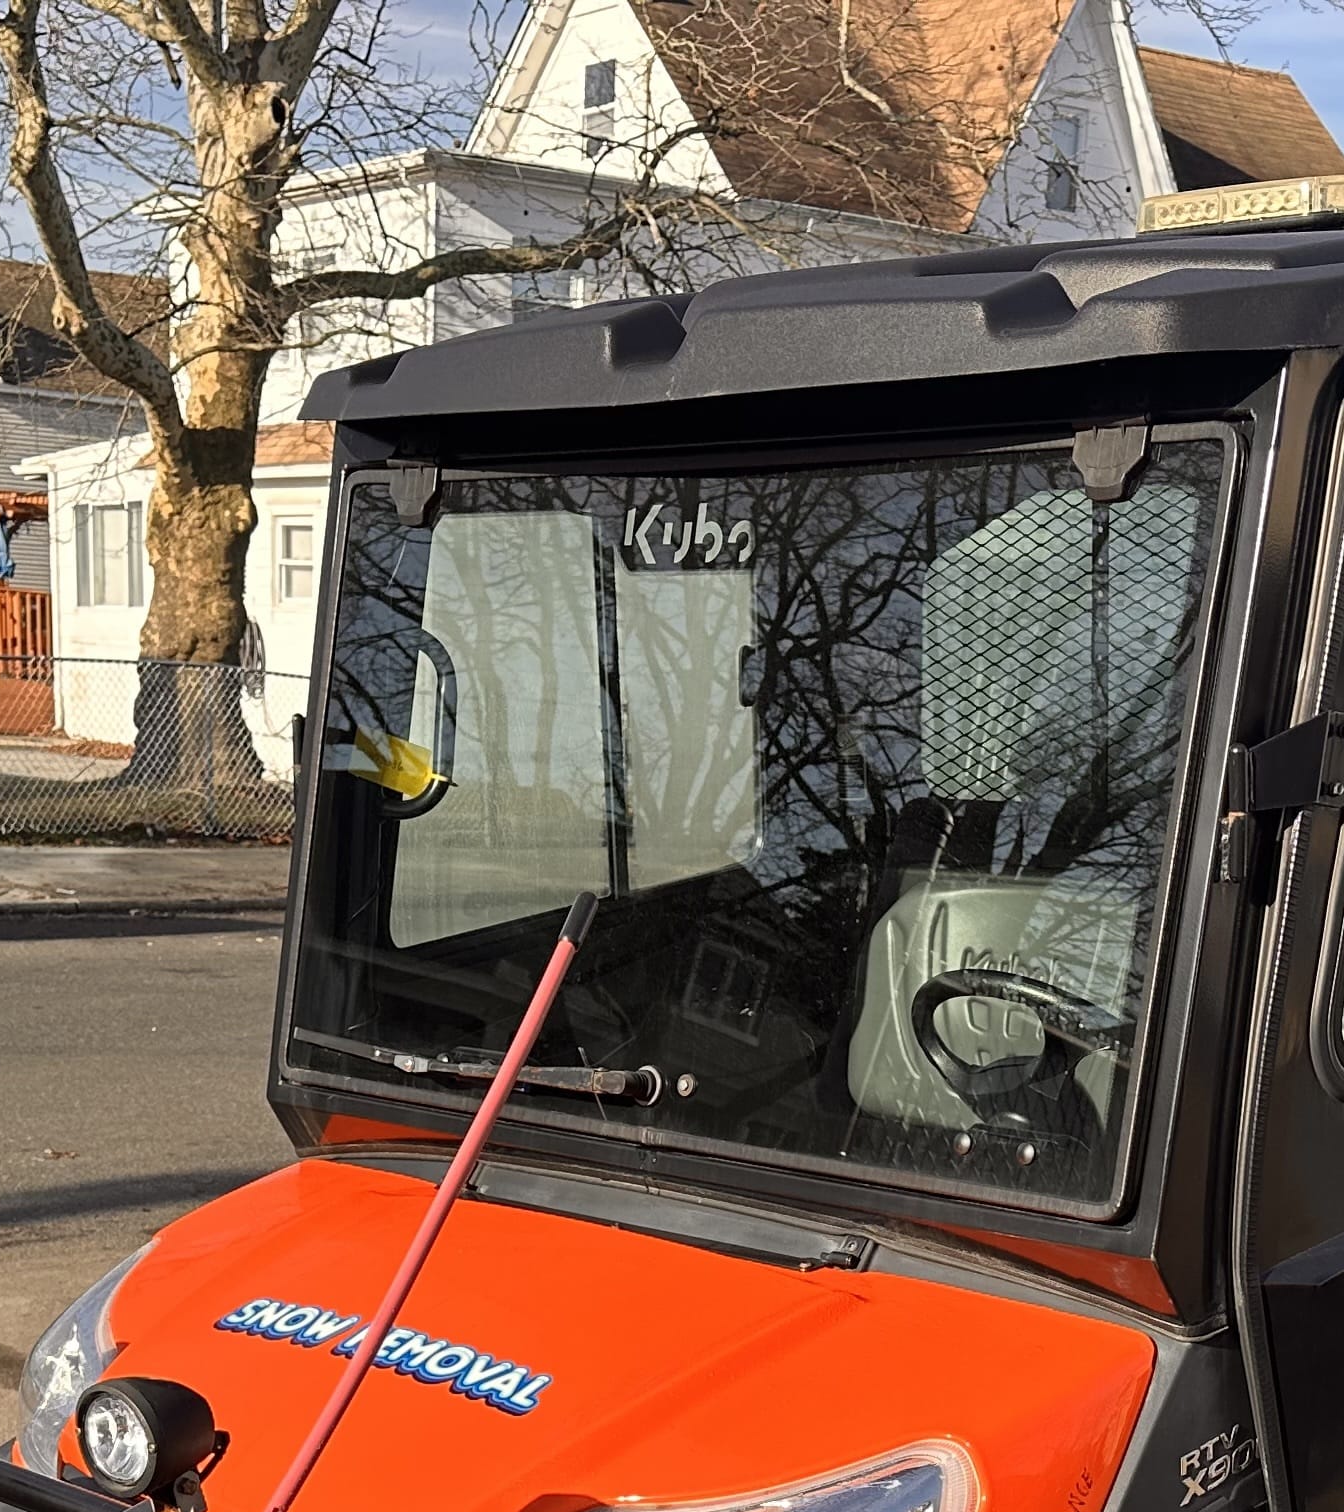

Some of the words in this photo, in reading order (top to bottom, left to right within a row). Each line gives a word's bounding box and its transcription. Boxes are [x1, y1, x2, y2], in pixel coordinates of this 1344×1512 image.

[216, 1298, 361, 1345] SNOW
[1179, 1438, 1258, 1508] X90
[1180, 1423, 1240, 1477] RTV
